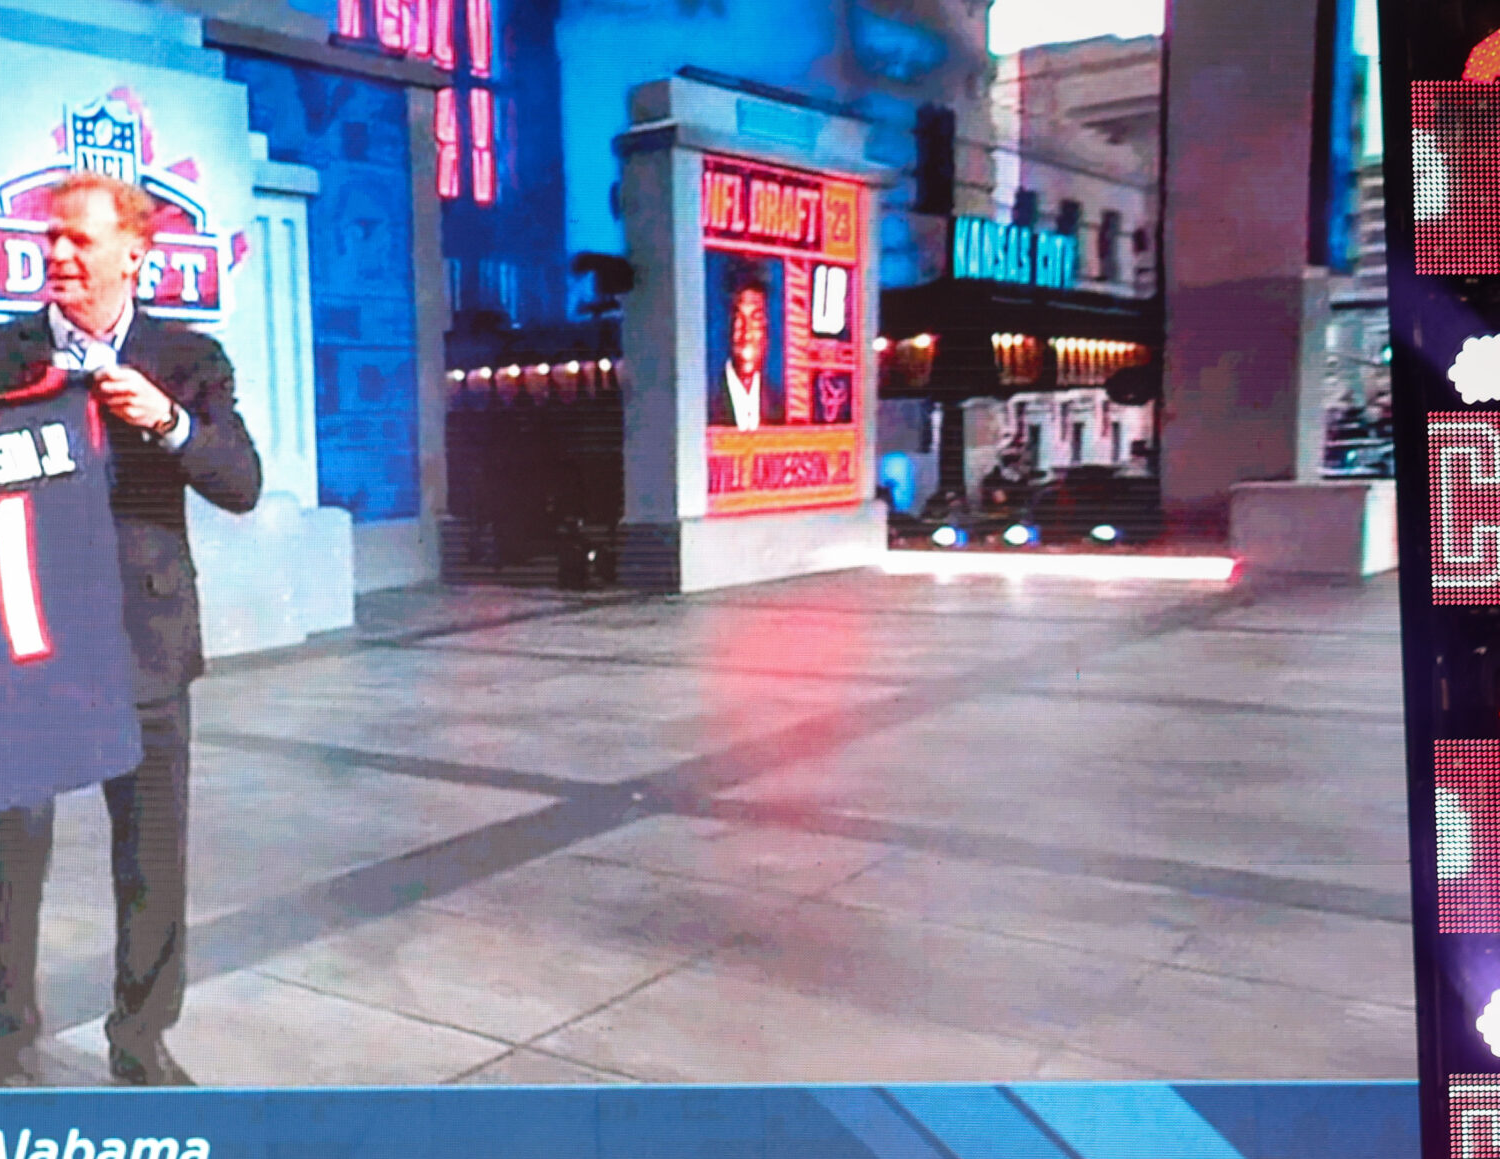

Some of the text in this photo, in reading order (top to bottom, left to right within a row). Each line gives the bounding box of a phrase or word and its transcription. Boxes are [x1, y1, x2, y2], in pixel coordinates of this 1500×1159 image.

[701, 172, 744, 231] NFL
[749, 179, 820, 242] DRAFT
[4, 239, 207, 302] DFT
[954, 216, 1031, 284] KANSAS
